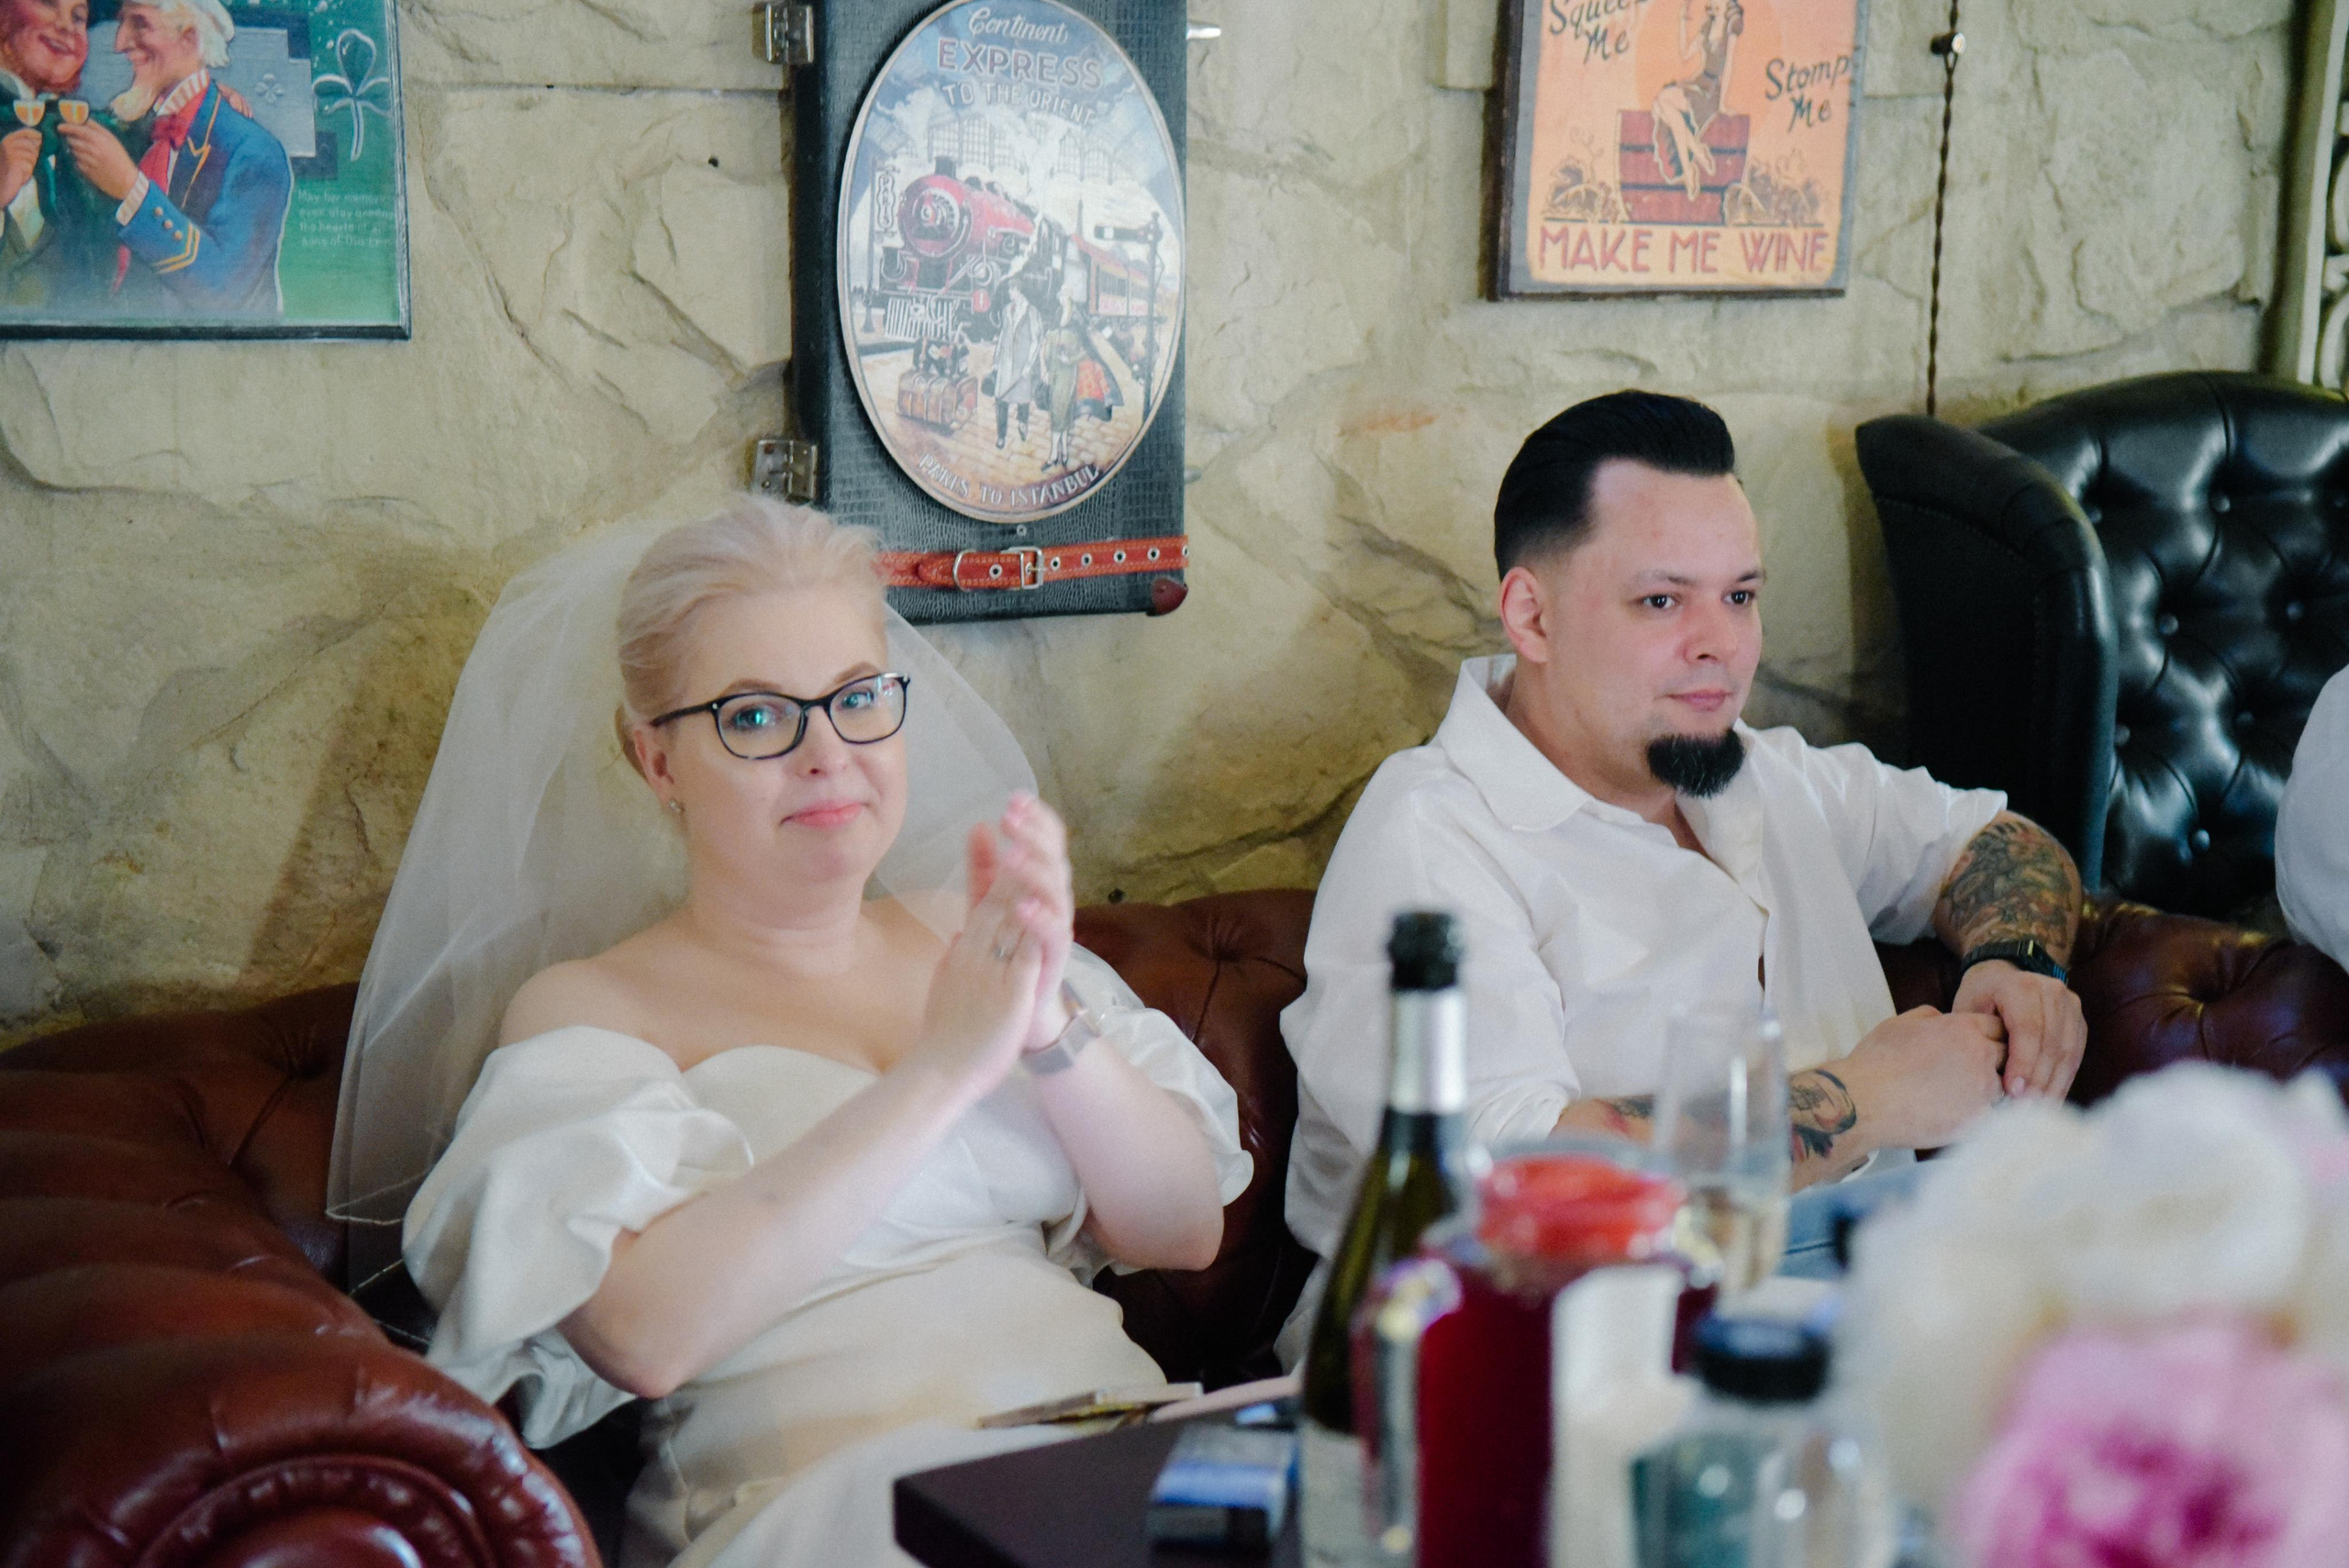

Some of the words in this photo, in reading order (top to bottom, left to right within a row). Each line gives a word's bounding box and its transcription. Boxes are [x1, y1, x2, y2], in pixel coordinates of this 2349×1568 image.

[938, 37, 1103, 91] EXPRESS
[1583, 24, 1630, 64] Me
[1765, 54, 1850, 101] Stomp
[942, 82, 974, 106] TO
[982, 83, 1022, 106] THE
[1028, 89, 1097, 126] ORIENT
[1786, 93, 1831, 133] Me
[1540, 227, 1652, 272] MAKE
[1668, 230, 1720, 273] ME
[1739, 229, 1829, 272] WINE
[918, 452, 969, 498] PARIS
[980, 481, 1002, 506] TO
[1010, 463, 1099, 507] ISTANBUL
